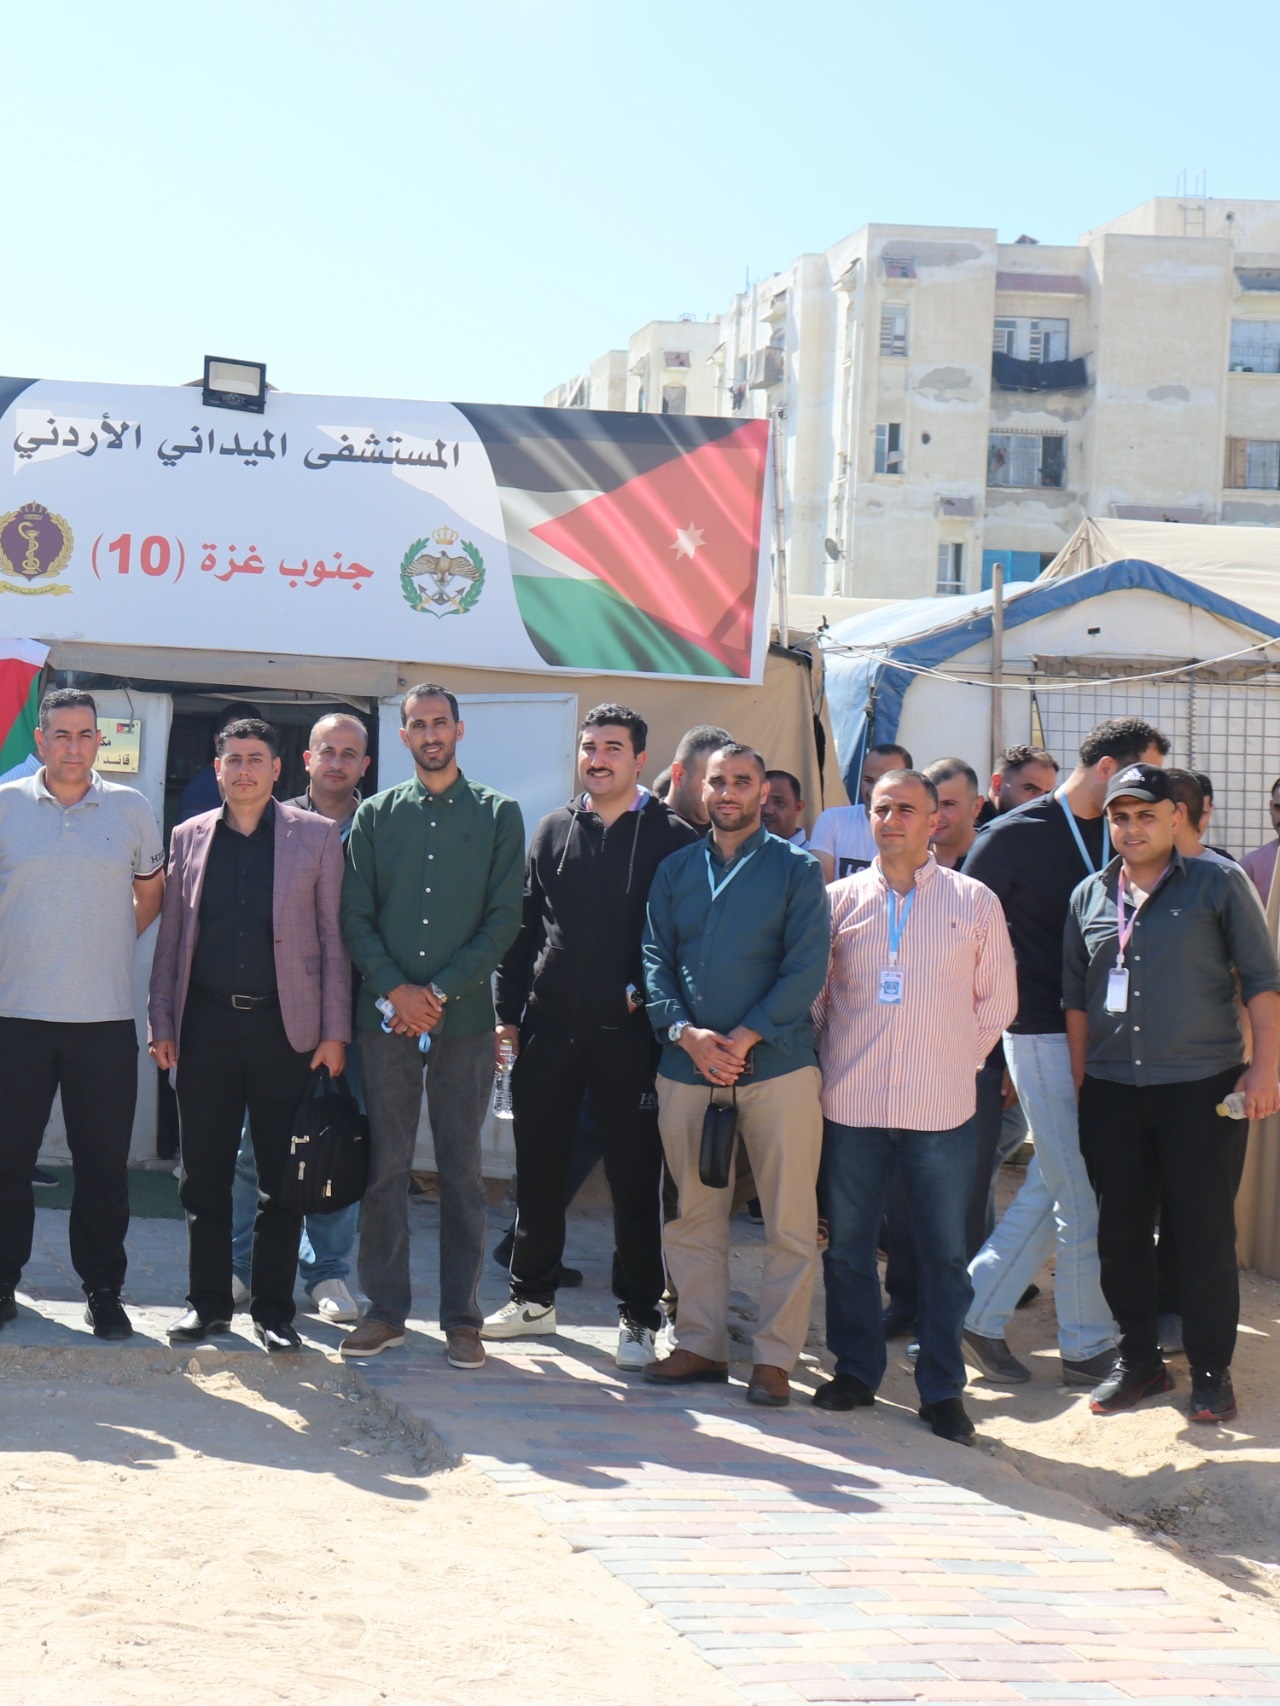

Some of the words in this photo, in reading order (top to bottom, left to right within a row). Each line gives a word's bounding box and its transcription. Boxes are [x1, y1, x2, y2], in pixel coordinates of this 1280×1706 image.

[13, 412, 142, 459] الأردني
[157, 426, 287, 467] الميداني
[303, 433, 460, 470] المستشفى
[91, 531, 186, 585] (10)
[200, 543, 266, 582] غزة
[278, 551, 375, 591] جنوب
